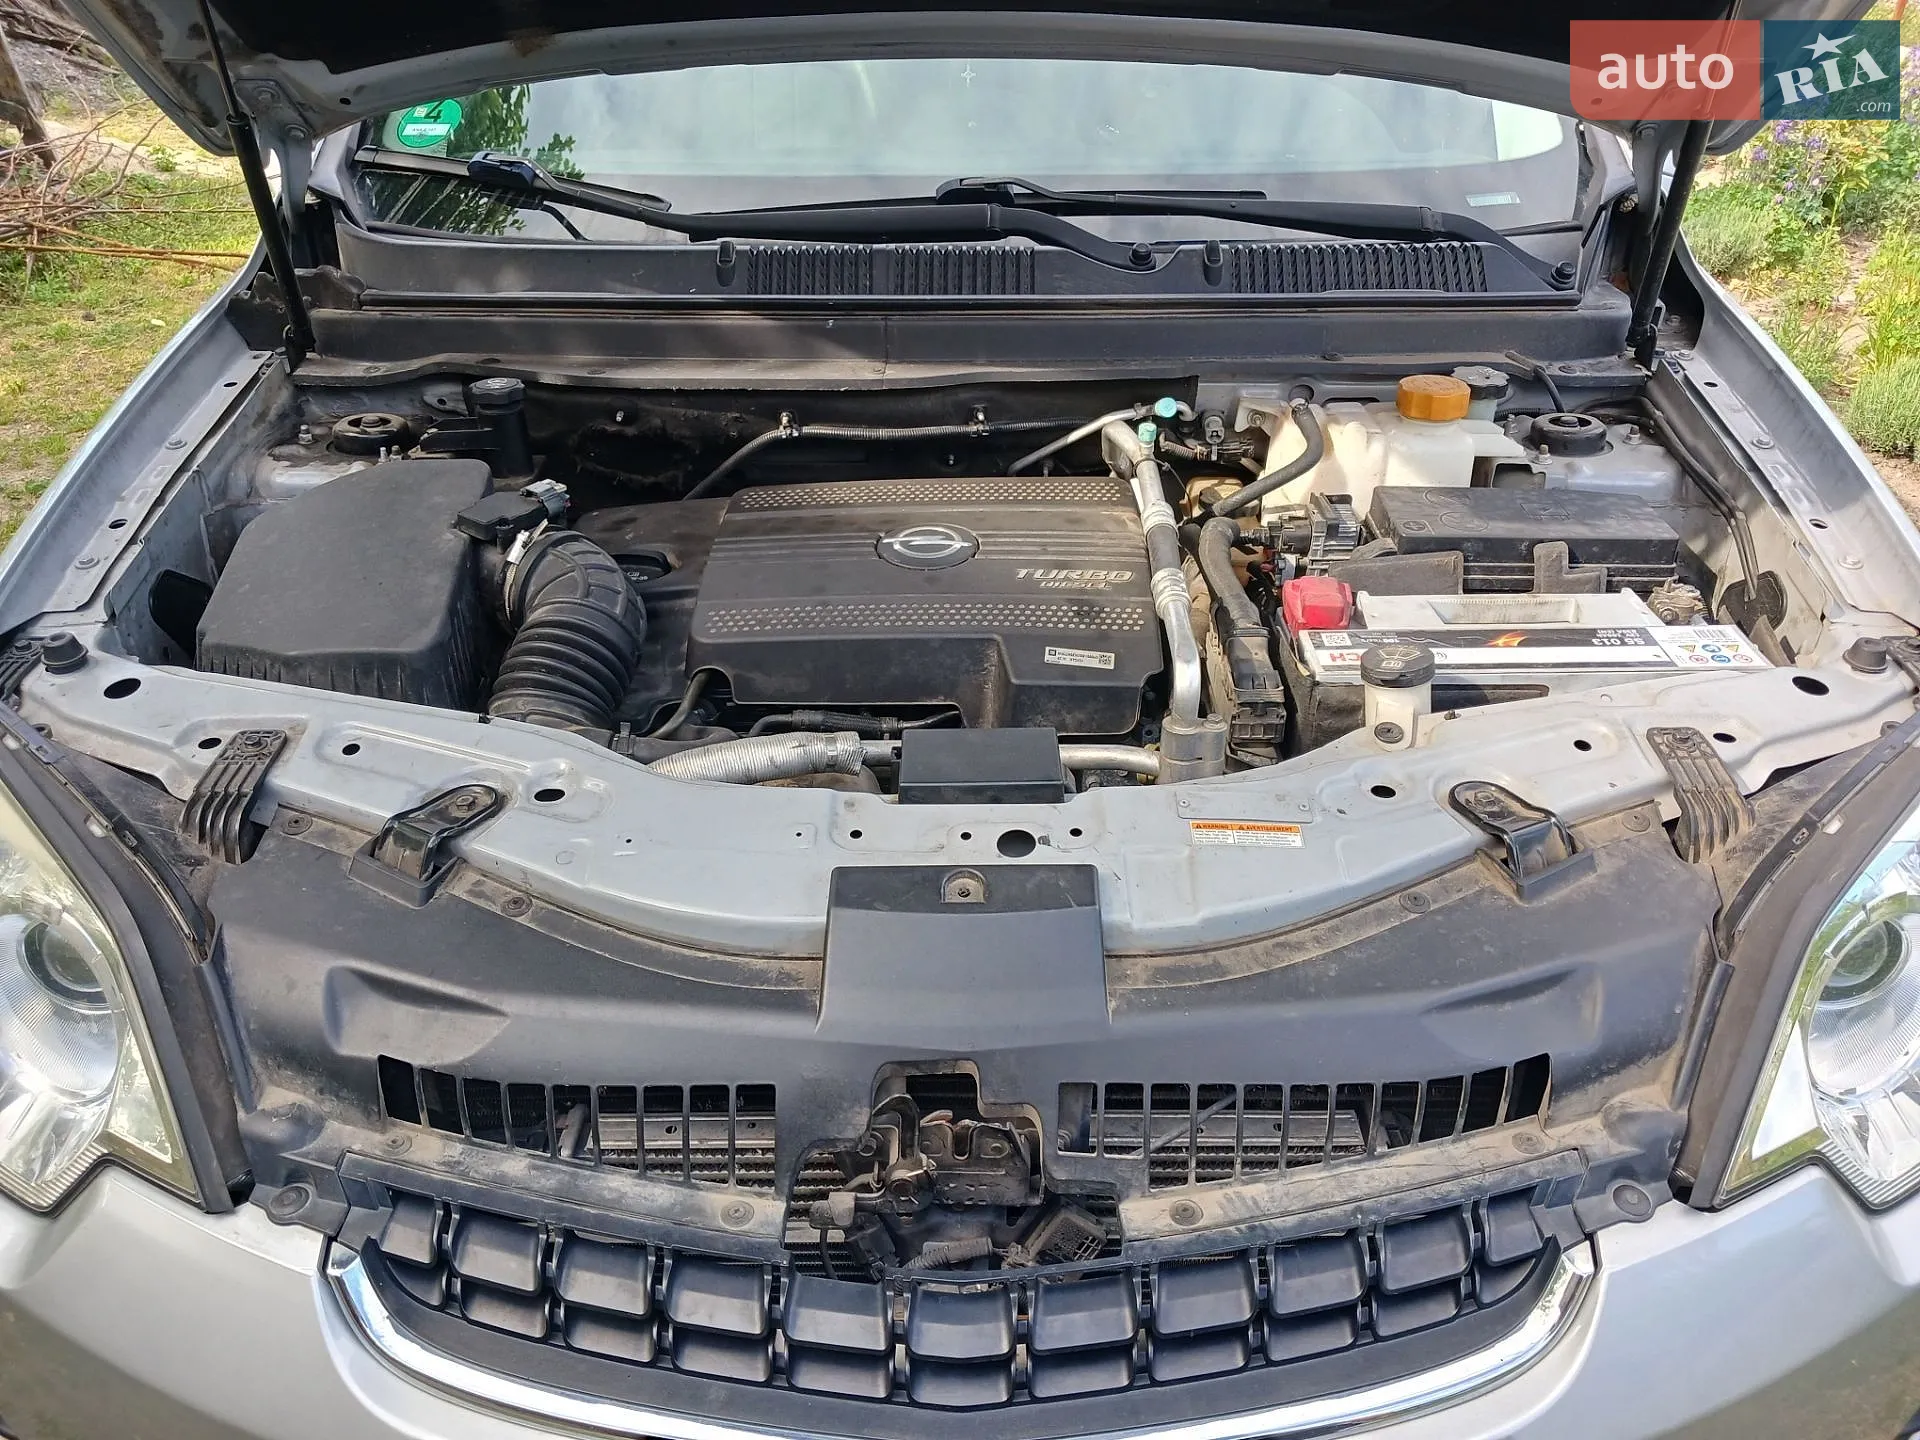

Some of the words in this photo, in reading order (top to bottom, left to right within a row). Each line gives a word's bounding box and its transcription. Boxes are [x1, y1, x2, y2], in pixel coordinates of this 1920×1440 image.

[424, 99, 444, 122] 4
[1015, 568, 1135, 583] TURBO
[1040, 581, 1112, 590] DIESEL
[1591, 638, 1621, 646] 013
